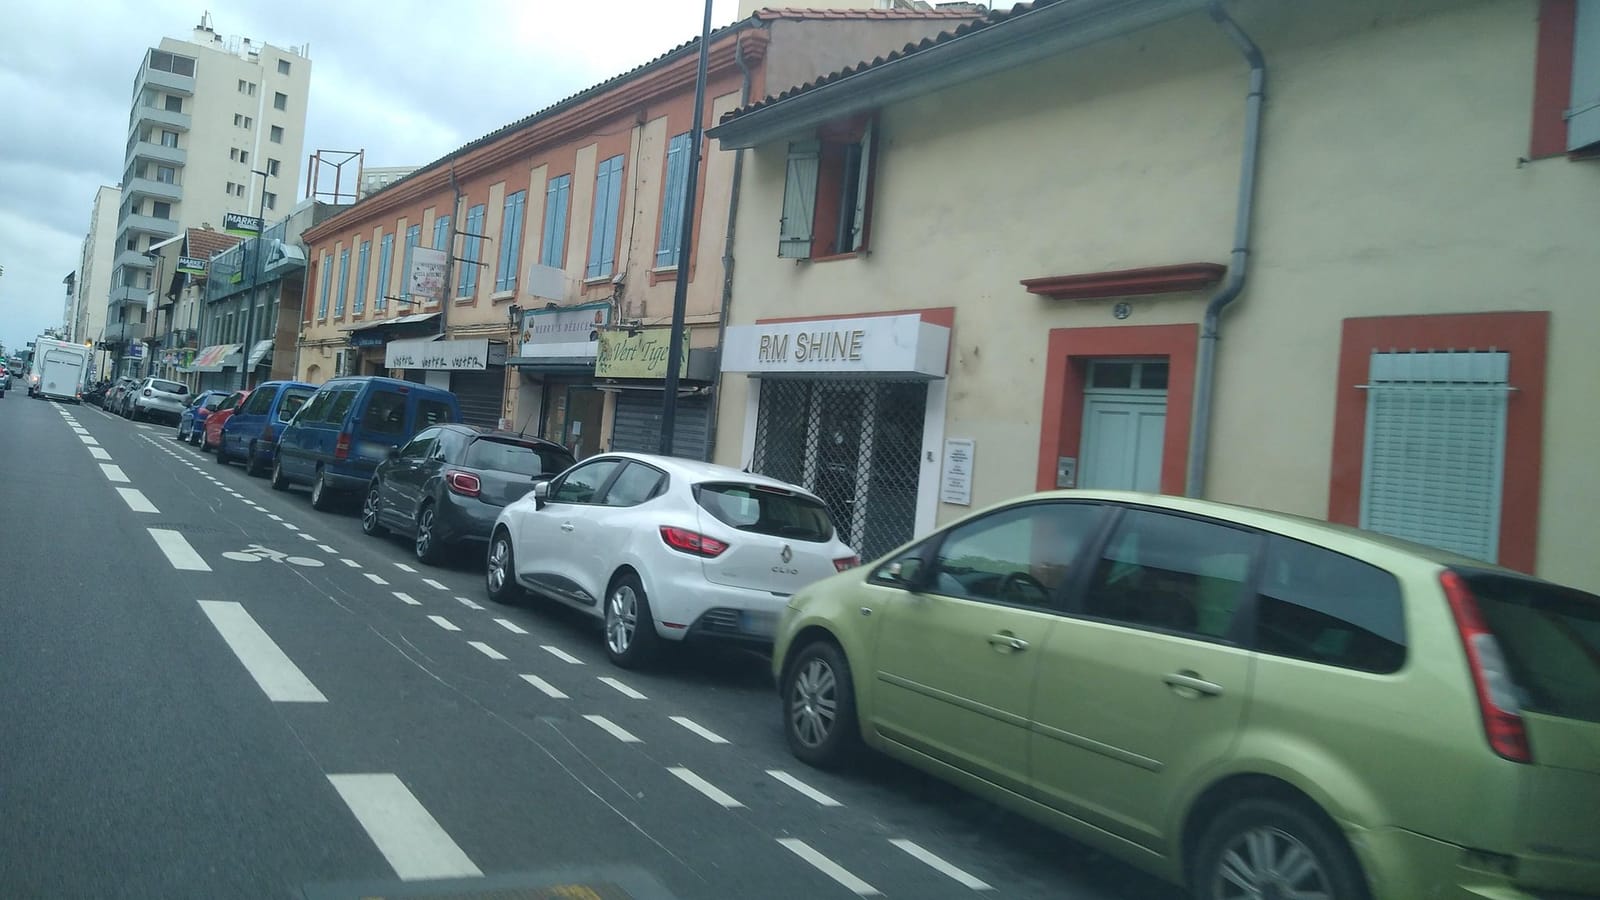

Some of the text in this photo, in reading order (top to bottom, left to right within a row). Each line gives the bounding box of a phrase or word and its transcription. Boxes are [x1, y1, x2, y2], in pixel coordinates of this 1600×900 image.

[227, 214, 261, 225] MARKE
[759, 330, 864, 362] RM SHINE
[771, 566, 798, 575] CLIO
